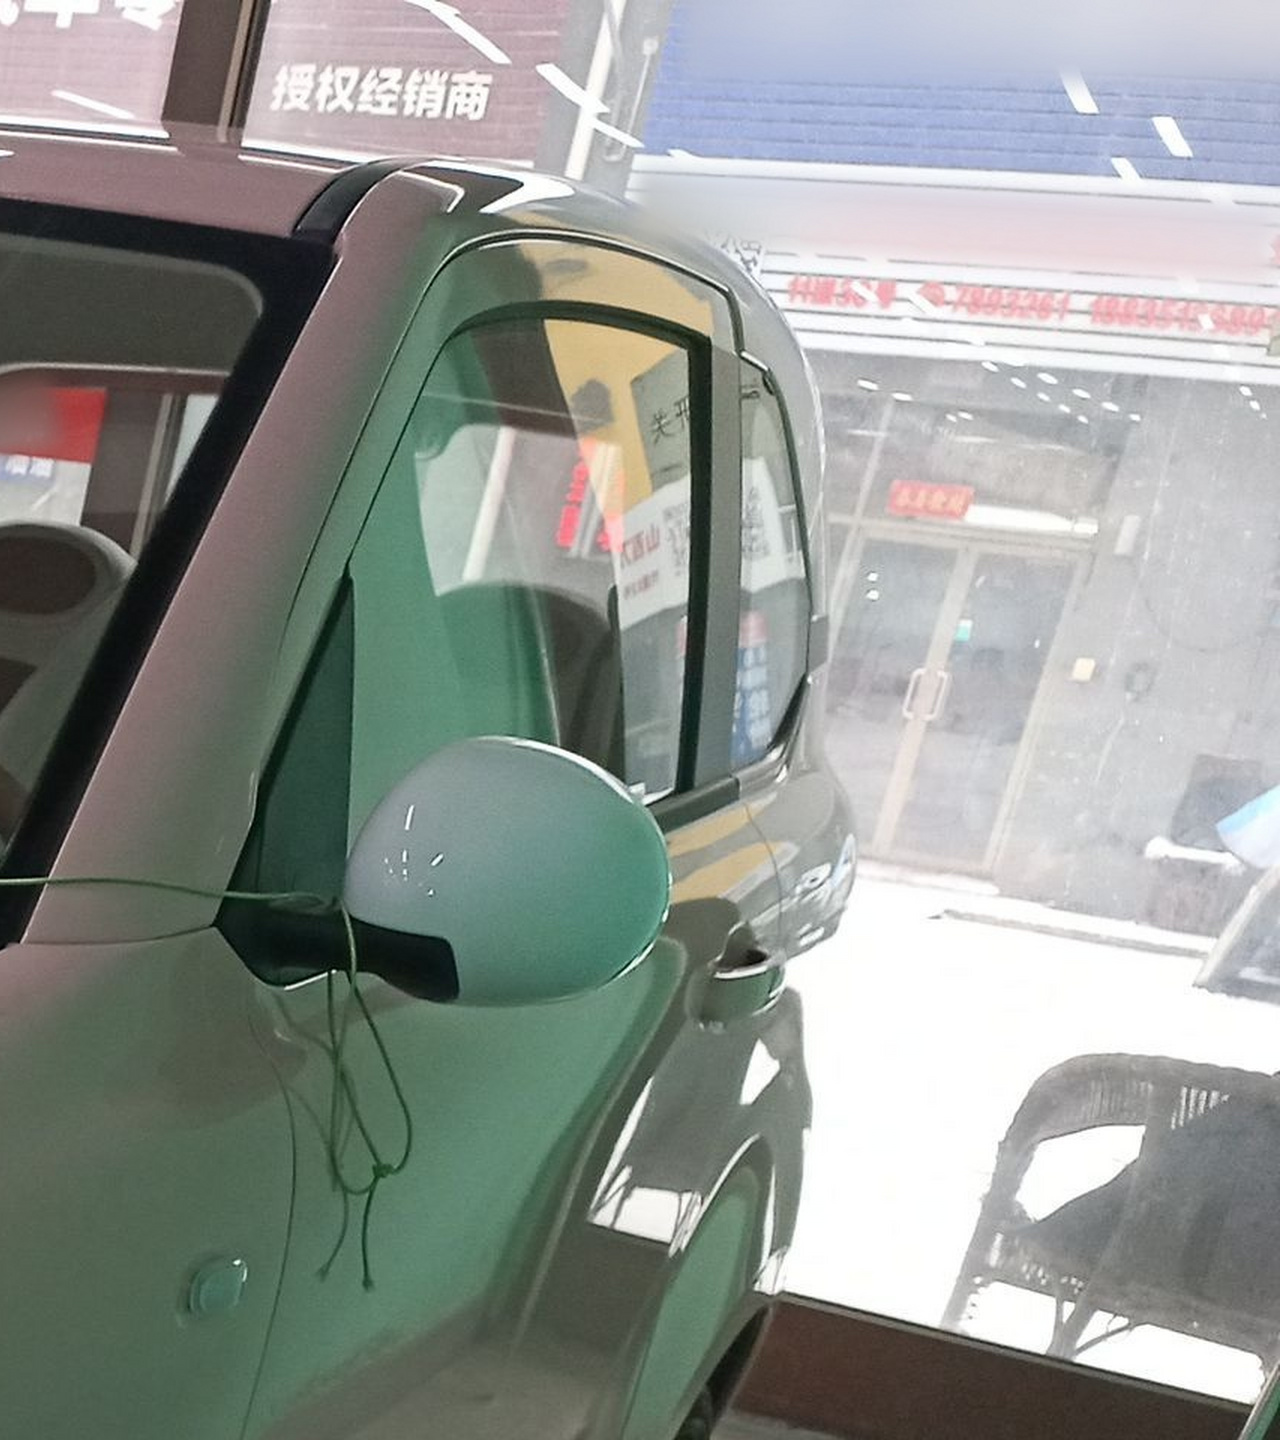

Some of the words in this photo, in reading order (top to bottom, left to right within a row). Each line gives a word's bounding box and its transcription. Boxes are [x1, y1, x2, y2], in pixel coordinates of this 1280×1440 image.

[270, 63, 494, 121] 授权经销商
